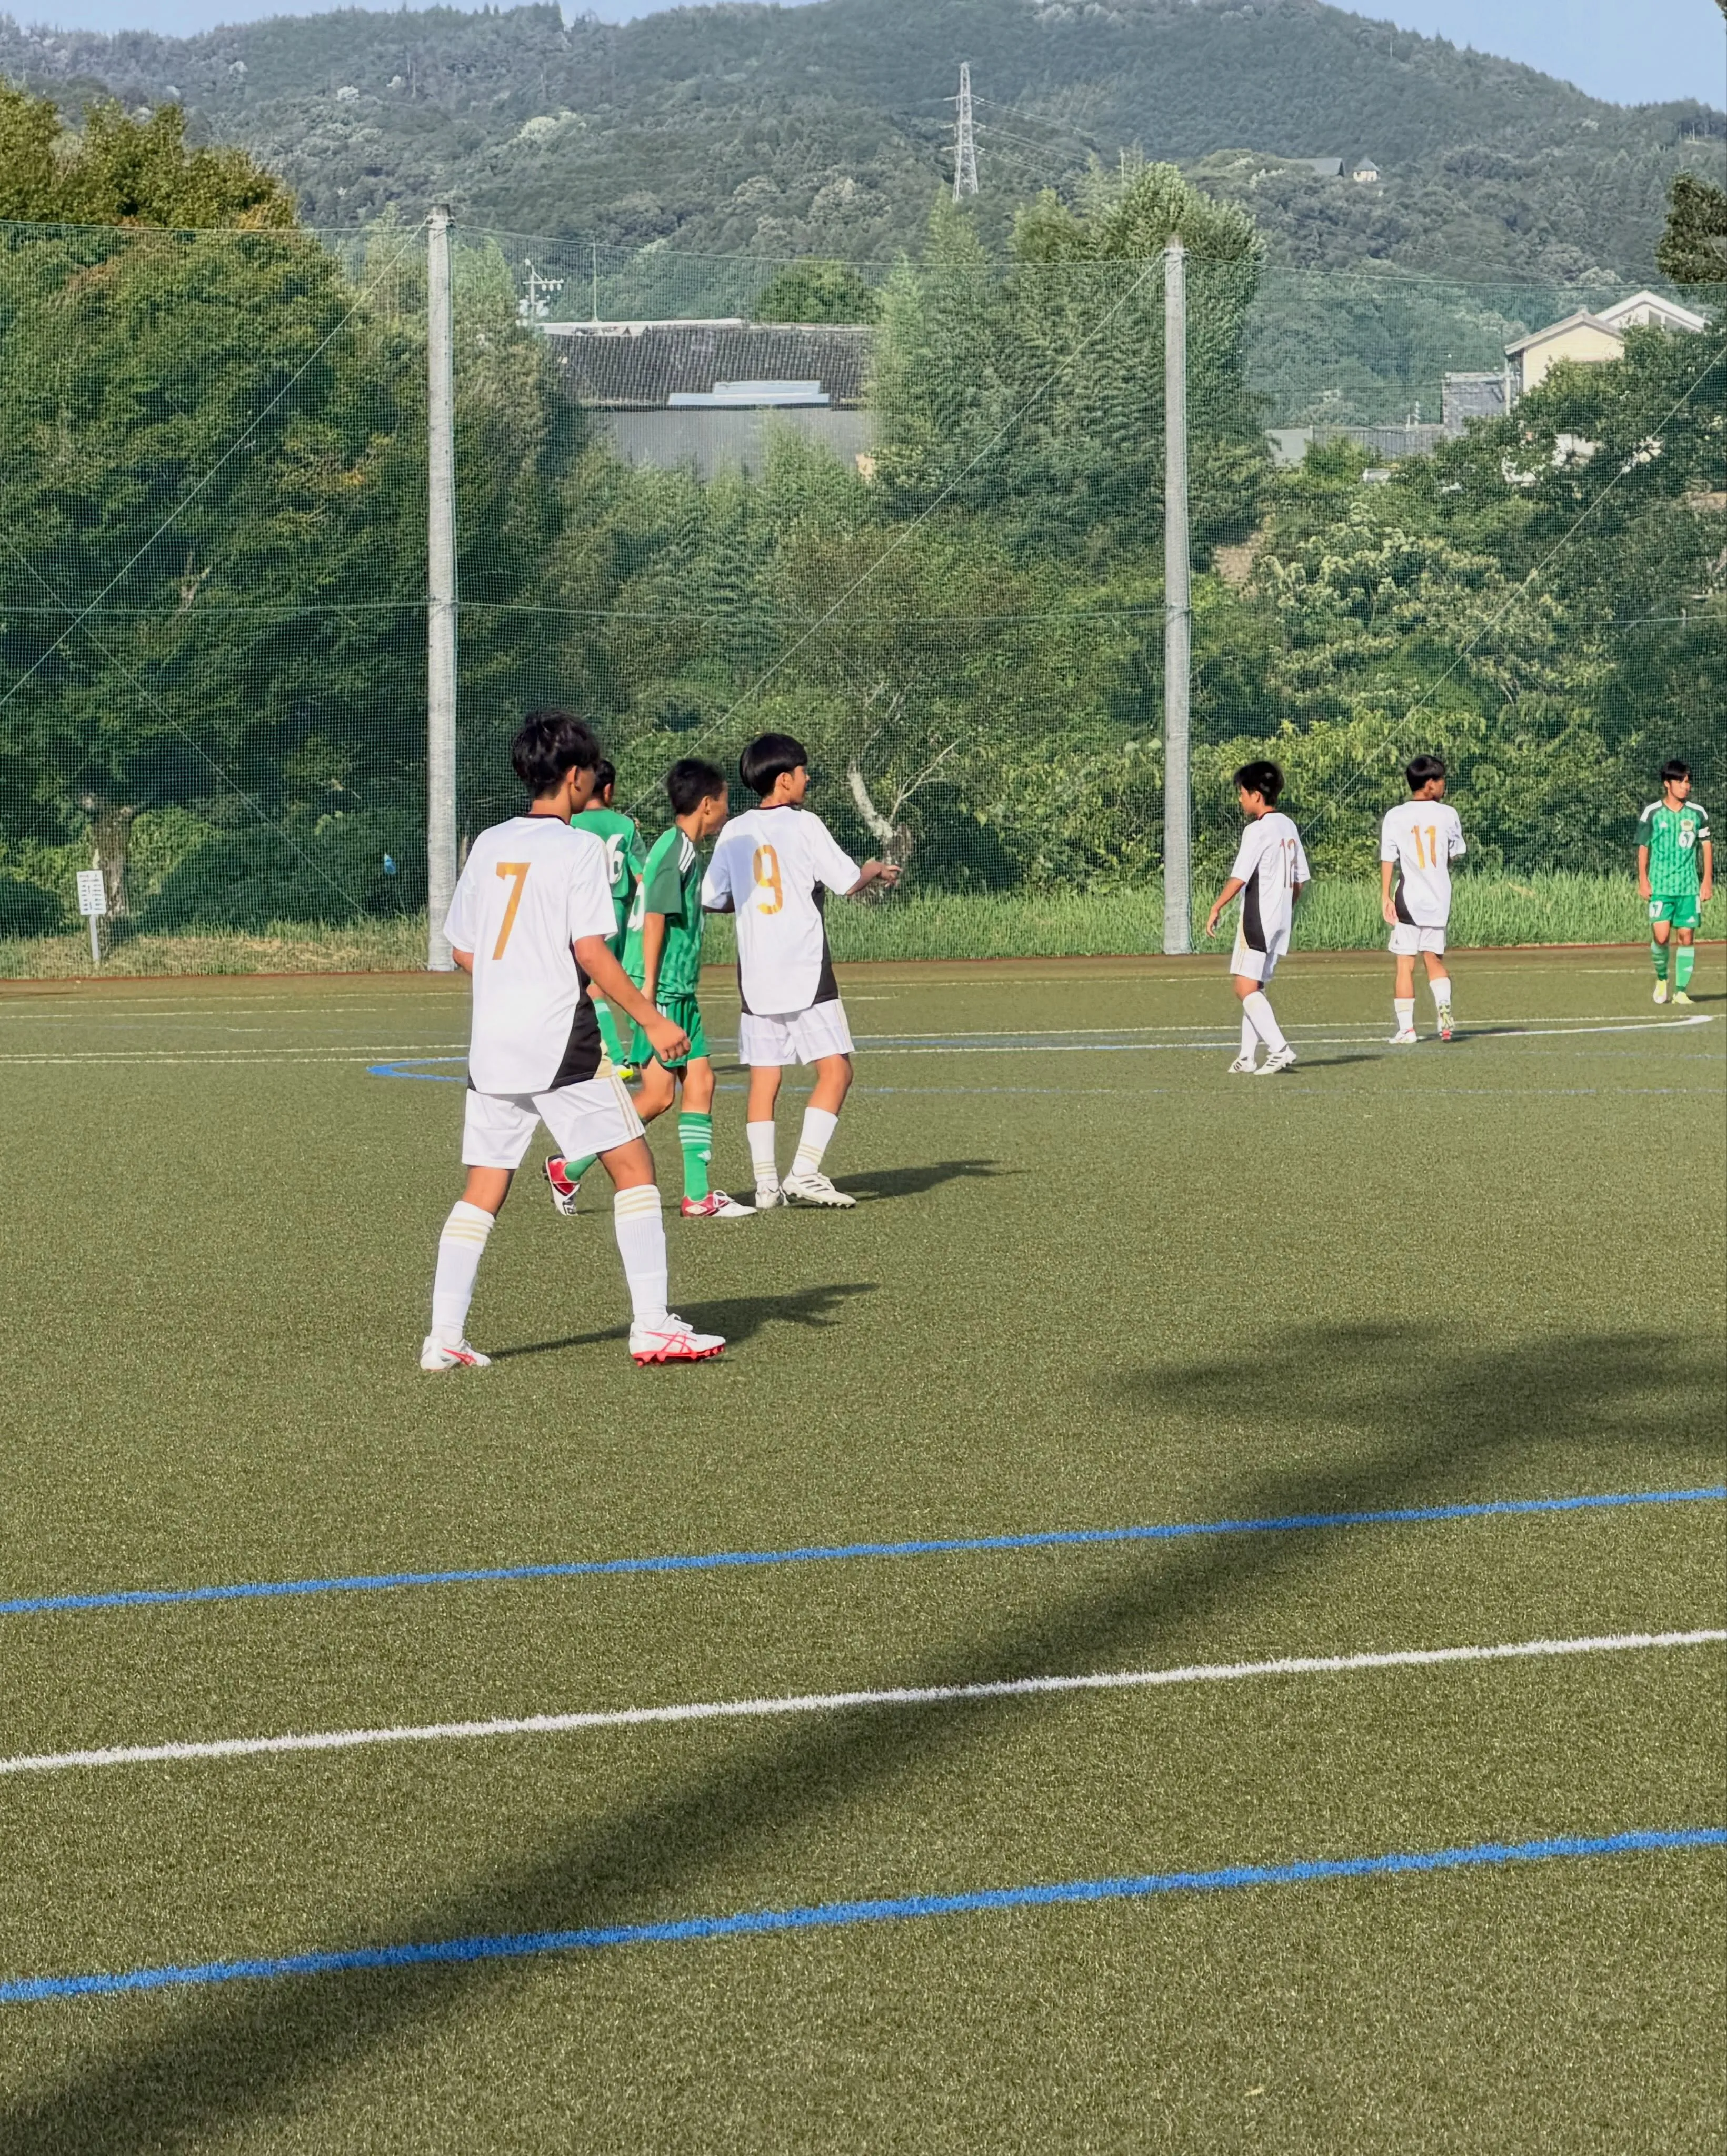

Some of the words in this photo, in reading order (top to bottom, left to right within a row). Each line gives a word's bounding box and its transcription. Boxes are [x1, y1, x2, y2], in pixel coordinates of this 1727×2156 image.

[1411, 825, 1436, 869] 11
[1679, 831, 1695, 849] 67
[753, 844, 783, 915] 9
[492, 862, 531, 960] 7
